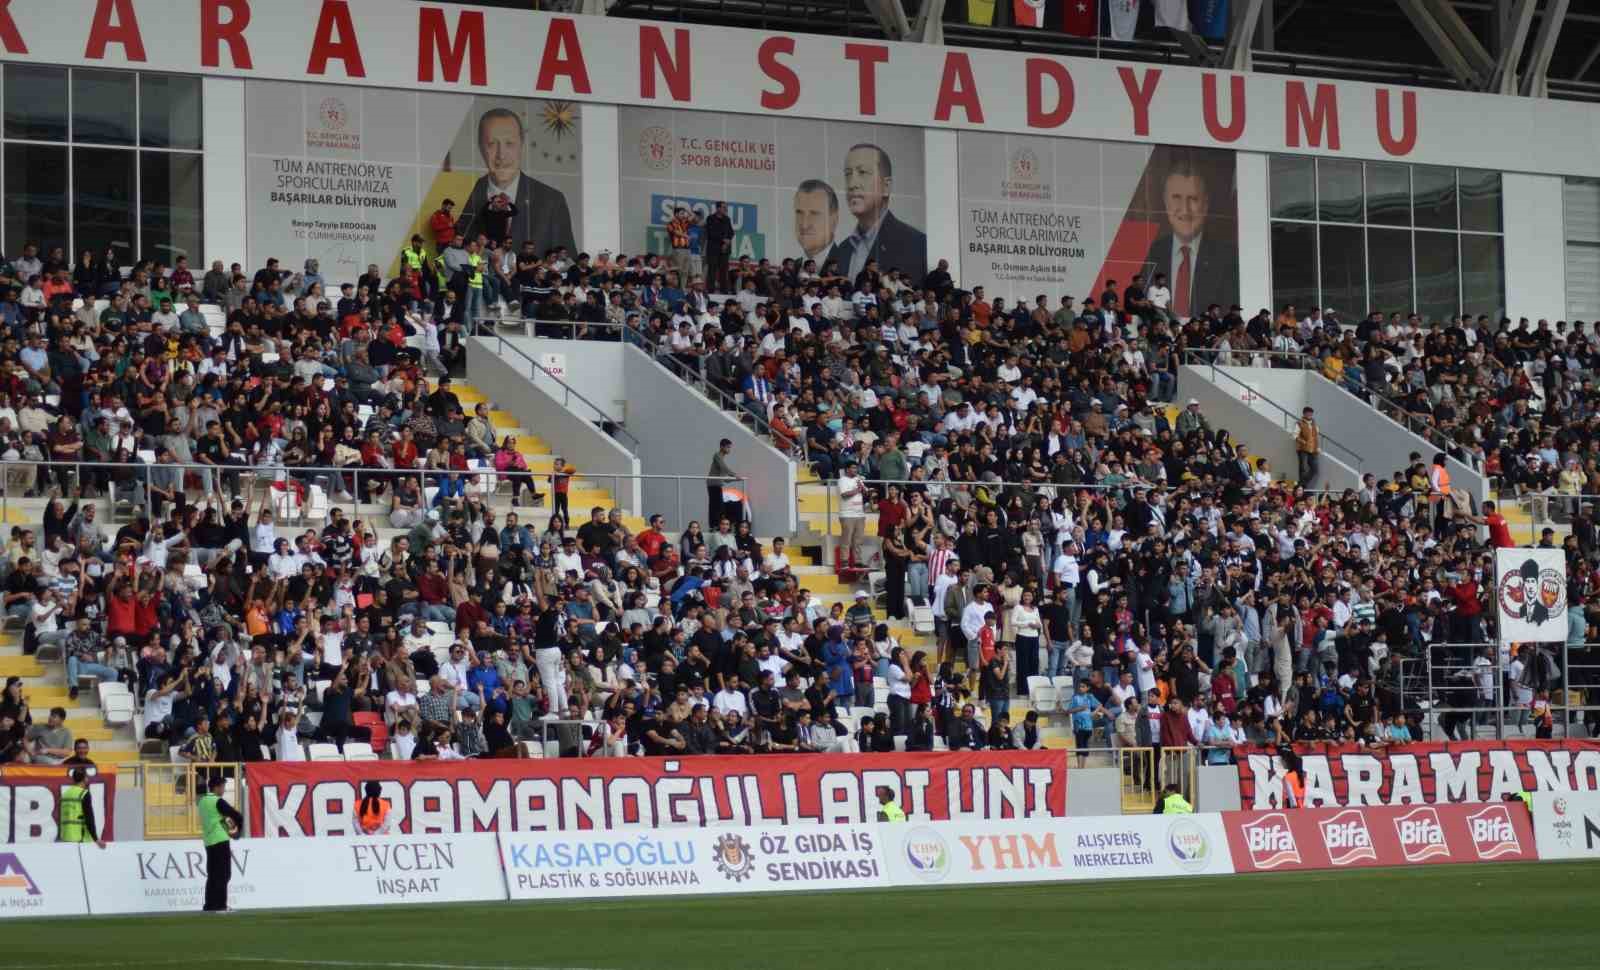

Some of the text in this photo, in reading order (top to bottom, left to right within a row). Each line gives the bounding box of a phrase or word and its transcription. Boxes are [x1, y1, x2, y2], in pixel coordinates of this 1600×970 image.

[757, 37, 1419, 156] STADYUMU
[680, 138, 775, 155] T.C. GENÇLİK VE
[273, 158, 393, 179] TÜM ANTRENÖR VE
[680, 154, 711, 167] SPOR
[277, 175, 390, 194] SPORCULARIMIZA
[270, 191, 397, 208] BAŞARILAR DİLİYORUM
[971, 208, 1081, 229] TÜM ANTRENÖR VE
[975, 225, 1079, 243] SPORCULARIMIZA
[969, 242, 1085, 259] BAŞARILAR DİLİYORUM
[1249, 825, 1294, 851] Bifa
[1326, 821, 1369, 848] Bifa
[1401, 818, 1443, 845] Bifa
[1473, 816, 1515, 842] Bifa
[760, 829, 874, 855] ÖZ GIDA İŞ
[1077, 830, 1142, 850] ALIŞVERİŞ
[351, 843, 456, 872] EVCEN
[511, 835, 696, 868] KASAPOĞLU
[959, 832, 1063, 871] YHM
[1073, 849, 1154, 867] MERKEZLERİ
[136, 848, 251, 880] KARV
[766, 858, 879, 882] SENDİKASI
[376, 876, 441, 897] İNŞAAT
[518, 868, 700, 889] PLASTİK & SOĞUKHAVA
